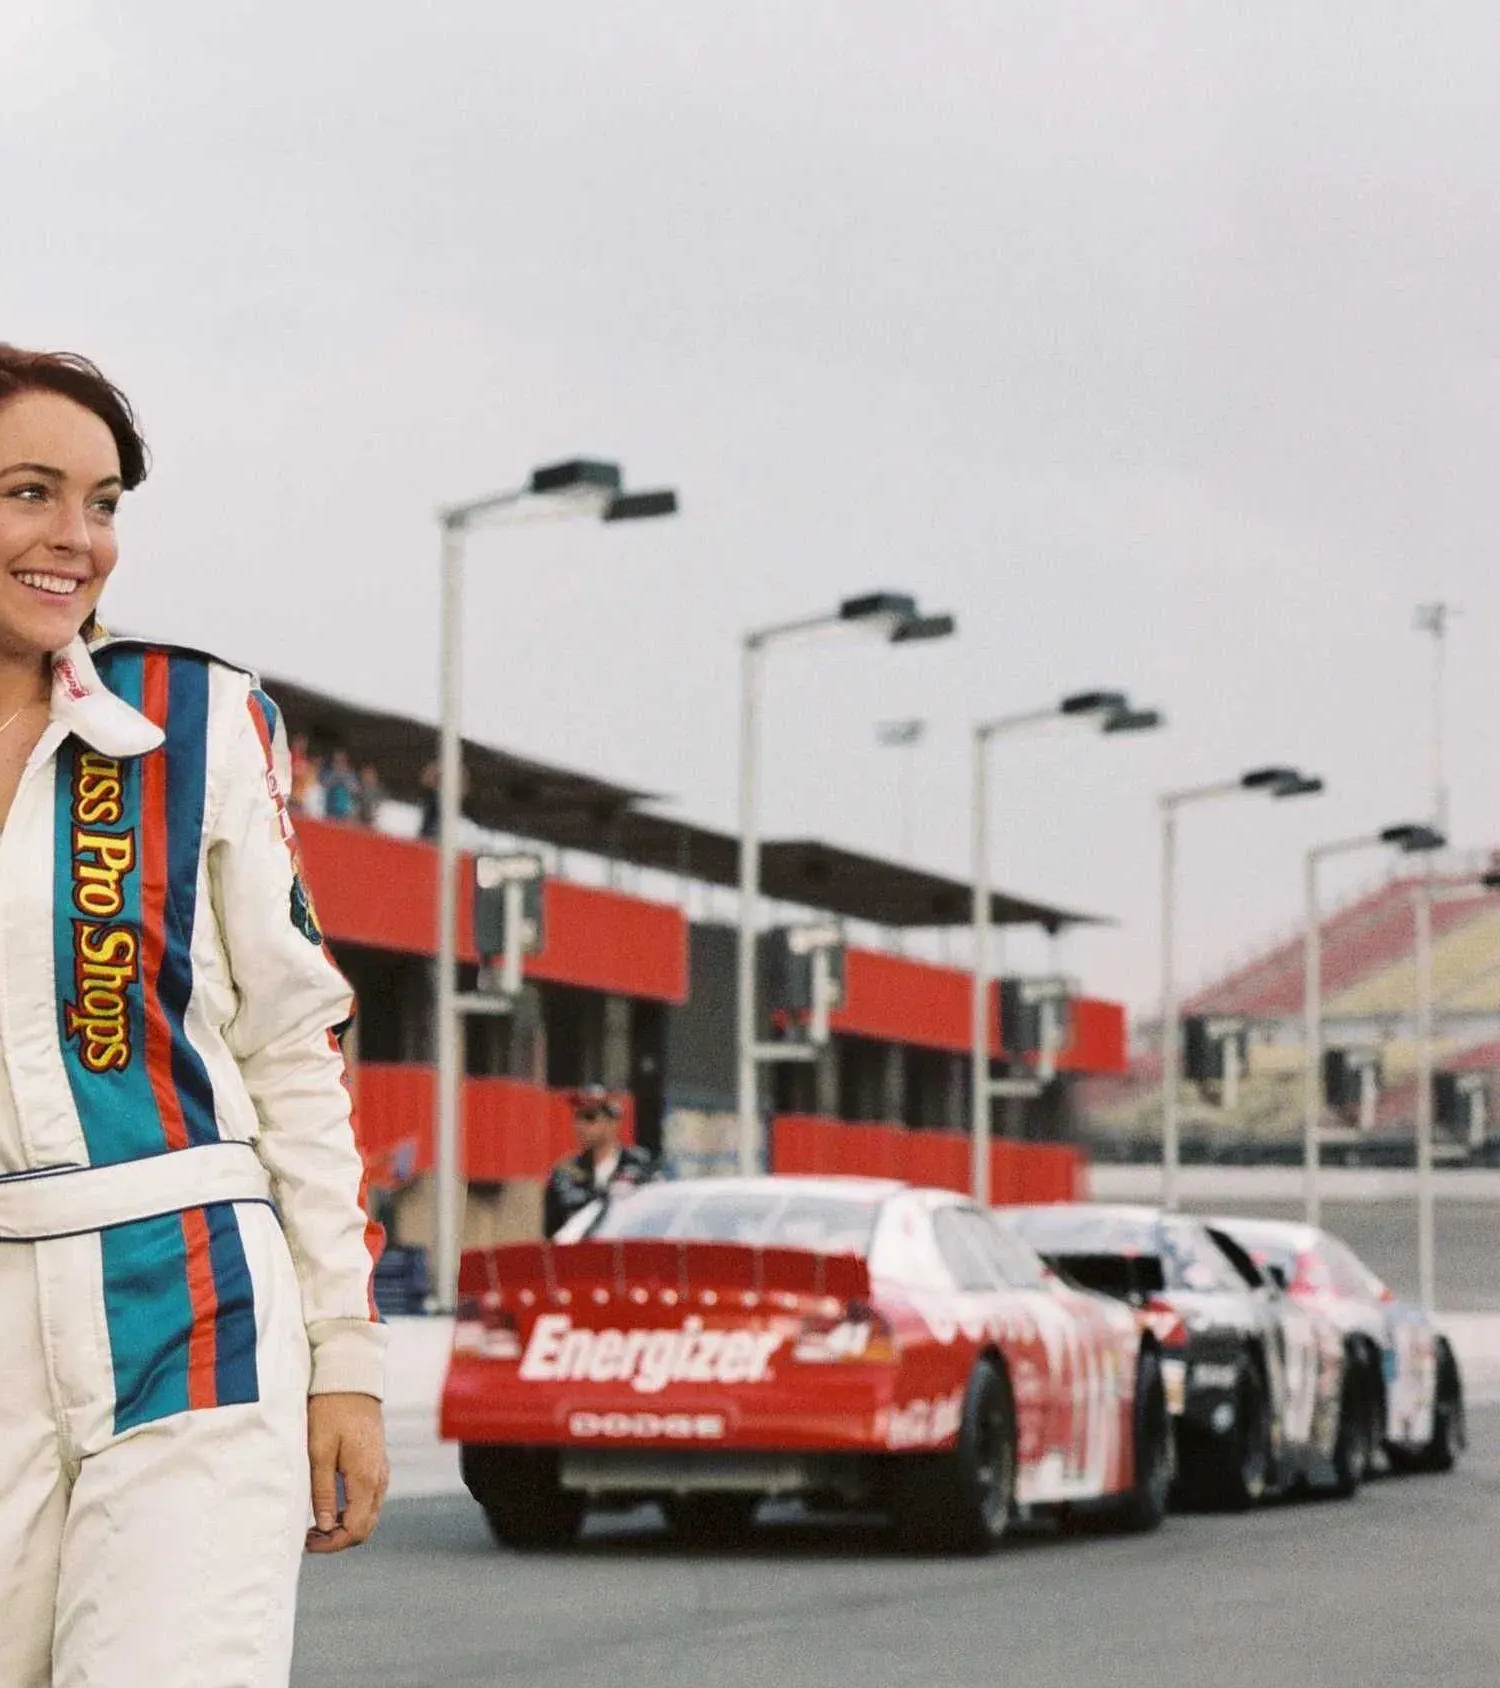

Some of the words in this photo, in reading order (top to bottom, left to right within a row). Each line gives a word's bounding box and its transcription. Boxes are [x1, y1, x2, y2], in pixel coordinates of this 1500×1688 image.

[70, 750, 122, 825] ass
[71, 826, 136, 918] Pro
[63, 918, 140, 1073] Shops
[517, 1313, 781, 1393] Energizer
[569, 1413, 724, 1438] DODGE
